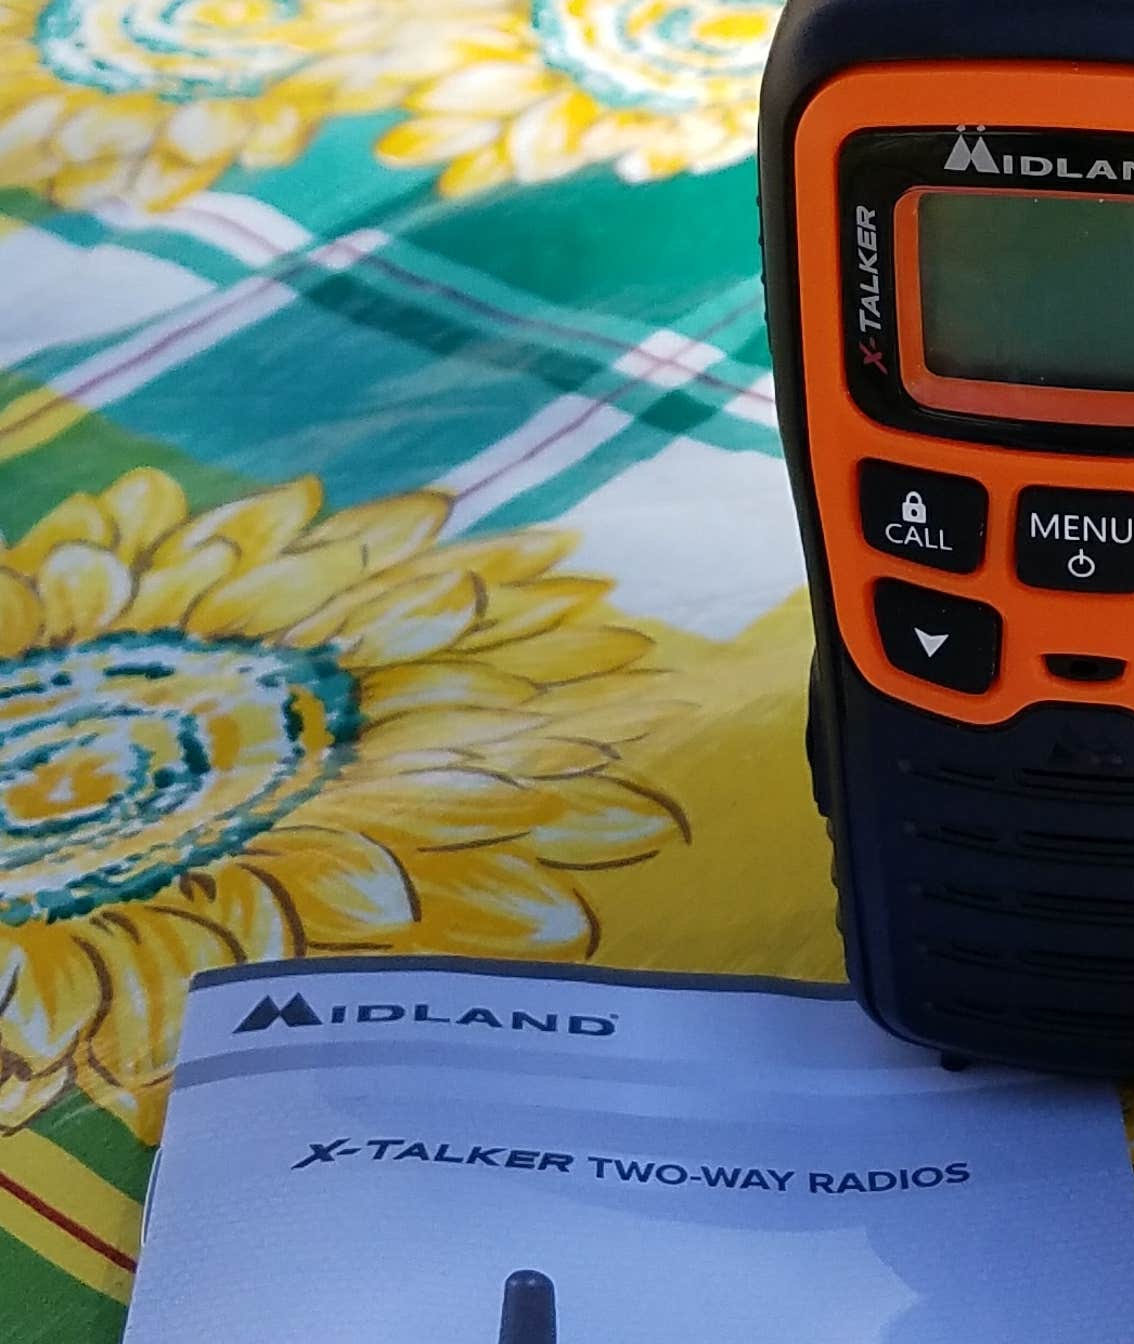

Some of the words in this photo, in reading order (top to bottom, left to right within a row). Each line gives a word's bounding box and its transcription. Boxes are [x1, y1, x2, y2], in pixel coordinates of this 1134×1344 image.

[856, 204, 888, 374] X-TALKER
[884, 523, 953, 552] CALL
[1029, 512, 1134, 545] MENU
[290, 1138, 574, 1174] X-TALKER
[587, 1157, 796, 1195] TWO-WAY
[808, 1161, 972, 1196] RADIOS
